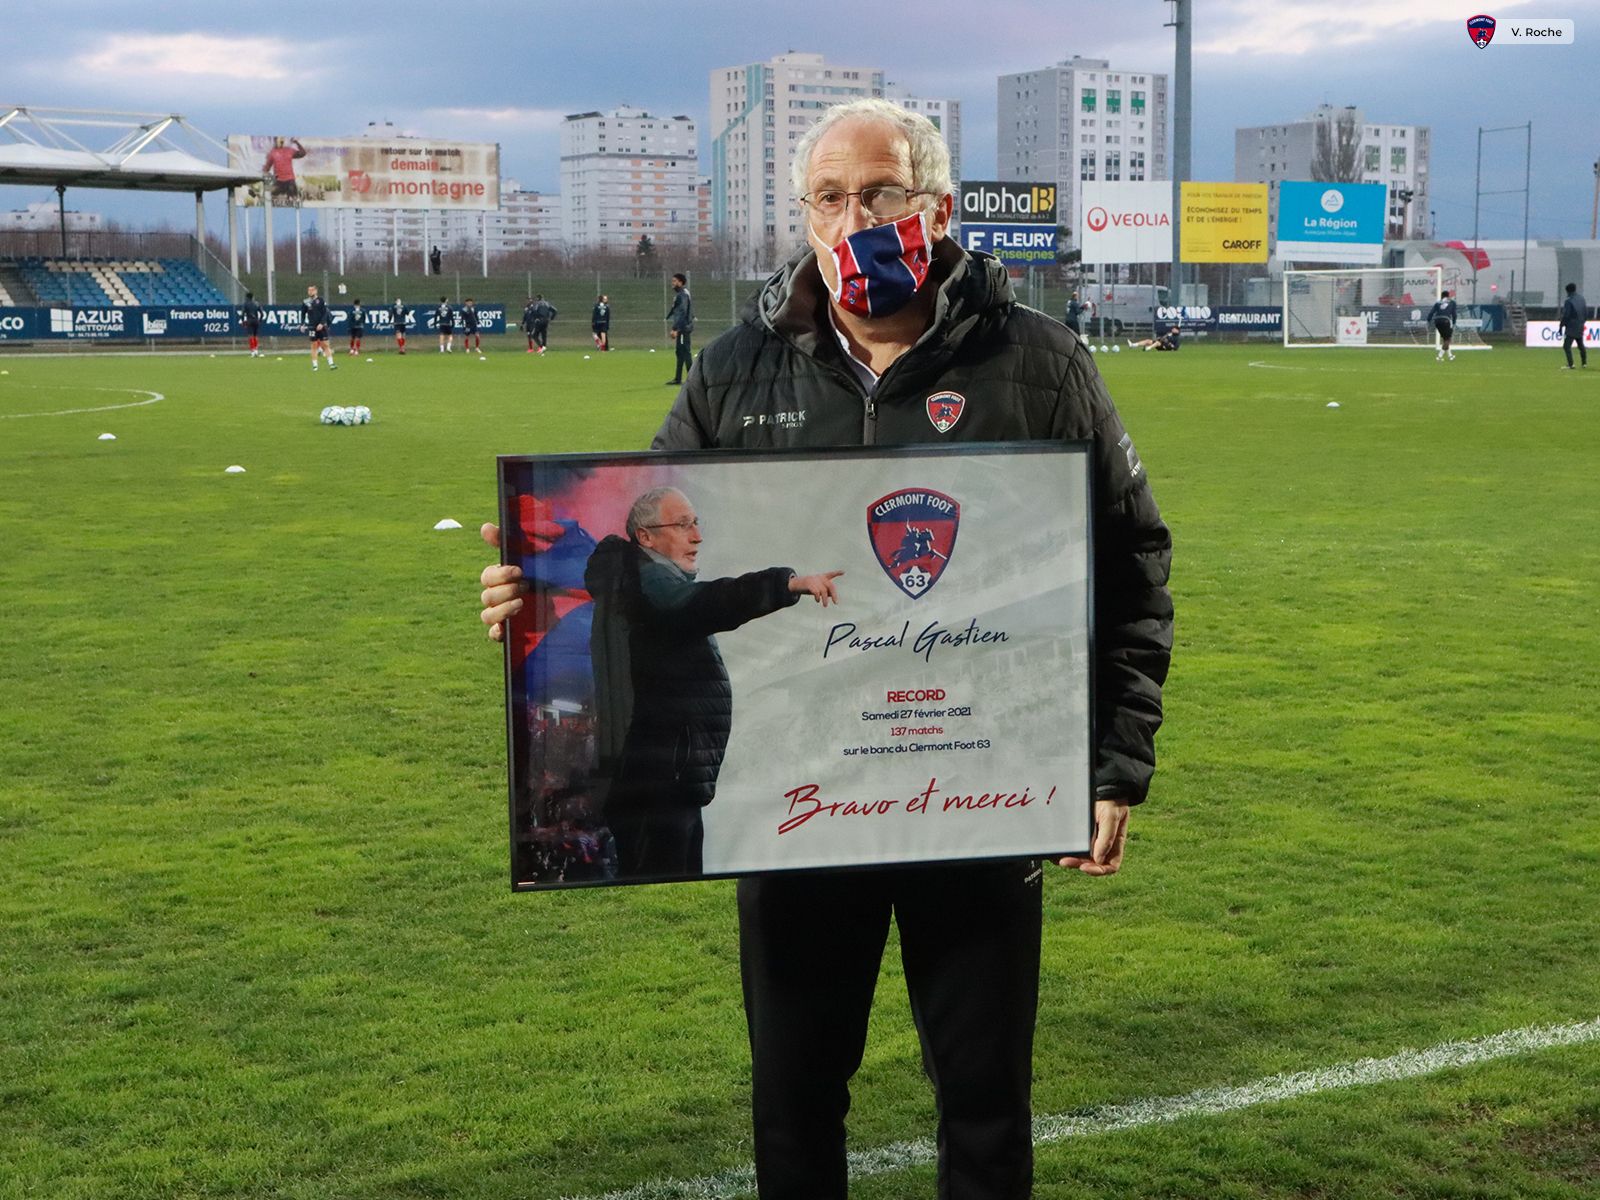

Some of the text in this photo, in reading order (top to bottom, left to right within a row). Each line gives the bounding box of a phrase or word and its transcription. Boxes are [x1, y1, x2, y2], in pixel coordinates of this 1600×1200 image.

[381, 147, 406, 155] retour
[425, 148, 433, 156] le
[391, 158, 439, 171] demain
[388, 179, 484, 200] montagne
[1112, 213, 1170, 226] VEOLIA
[1304, 217, 1357, 229] La Région
[993, 232, 1054, 247] FLEURY
[1222, 240, 1262, 249] CAROFF
[993, 248, 1054, 261] Enseignes
[75, 310, 123, 323] AZUR
[170, 309, 229, 319] france bleu
[0, 316, 24, 330] CO
[204, 323, 229, 332] 102.5
[760, 410, 806, 424] PATRICK
[875, 494, 953, 516] CLERMONT FOOT
[905, 575, 925, 587] 63
[824, 618, 1009, 663] Pascal Gastien
[888, 689, 946, 703] RECORD
[862, 707, 971, 720] Samedi 27 février 2021
[890, 726, 944, 736] 137 matchs
[860, 746, 868, 754] le
[870, 745, 894, 754] banc
[895, 744, 907, 753] du
[909, 742, 953, 752] Clermont
[954, 741, 976, 750] Foot
[976, 740, 990, 748] 63
[778, 784, 899, 835] Bravo
[906, 778, 940, 814] et
[943, 787, 1036, 812] merci
